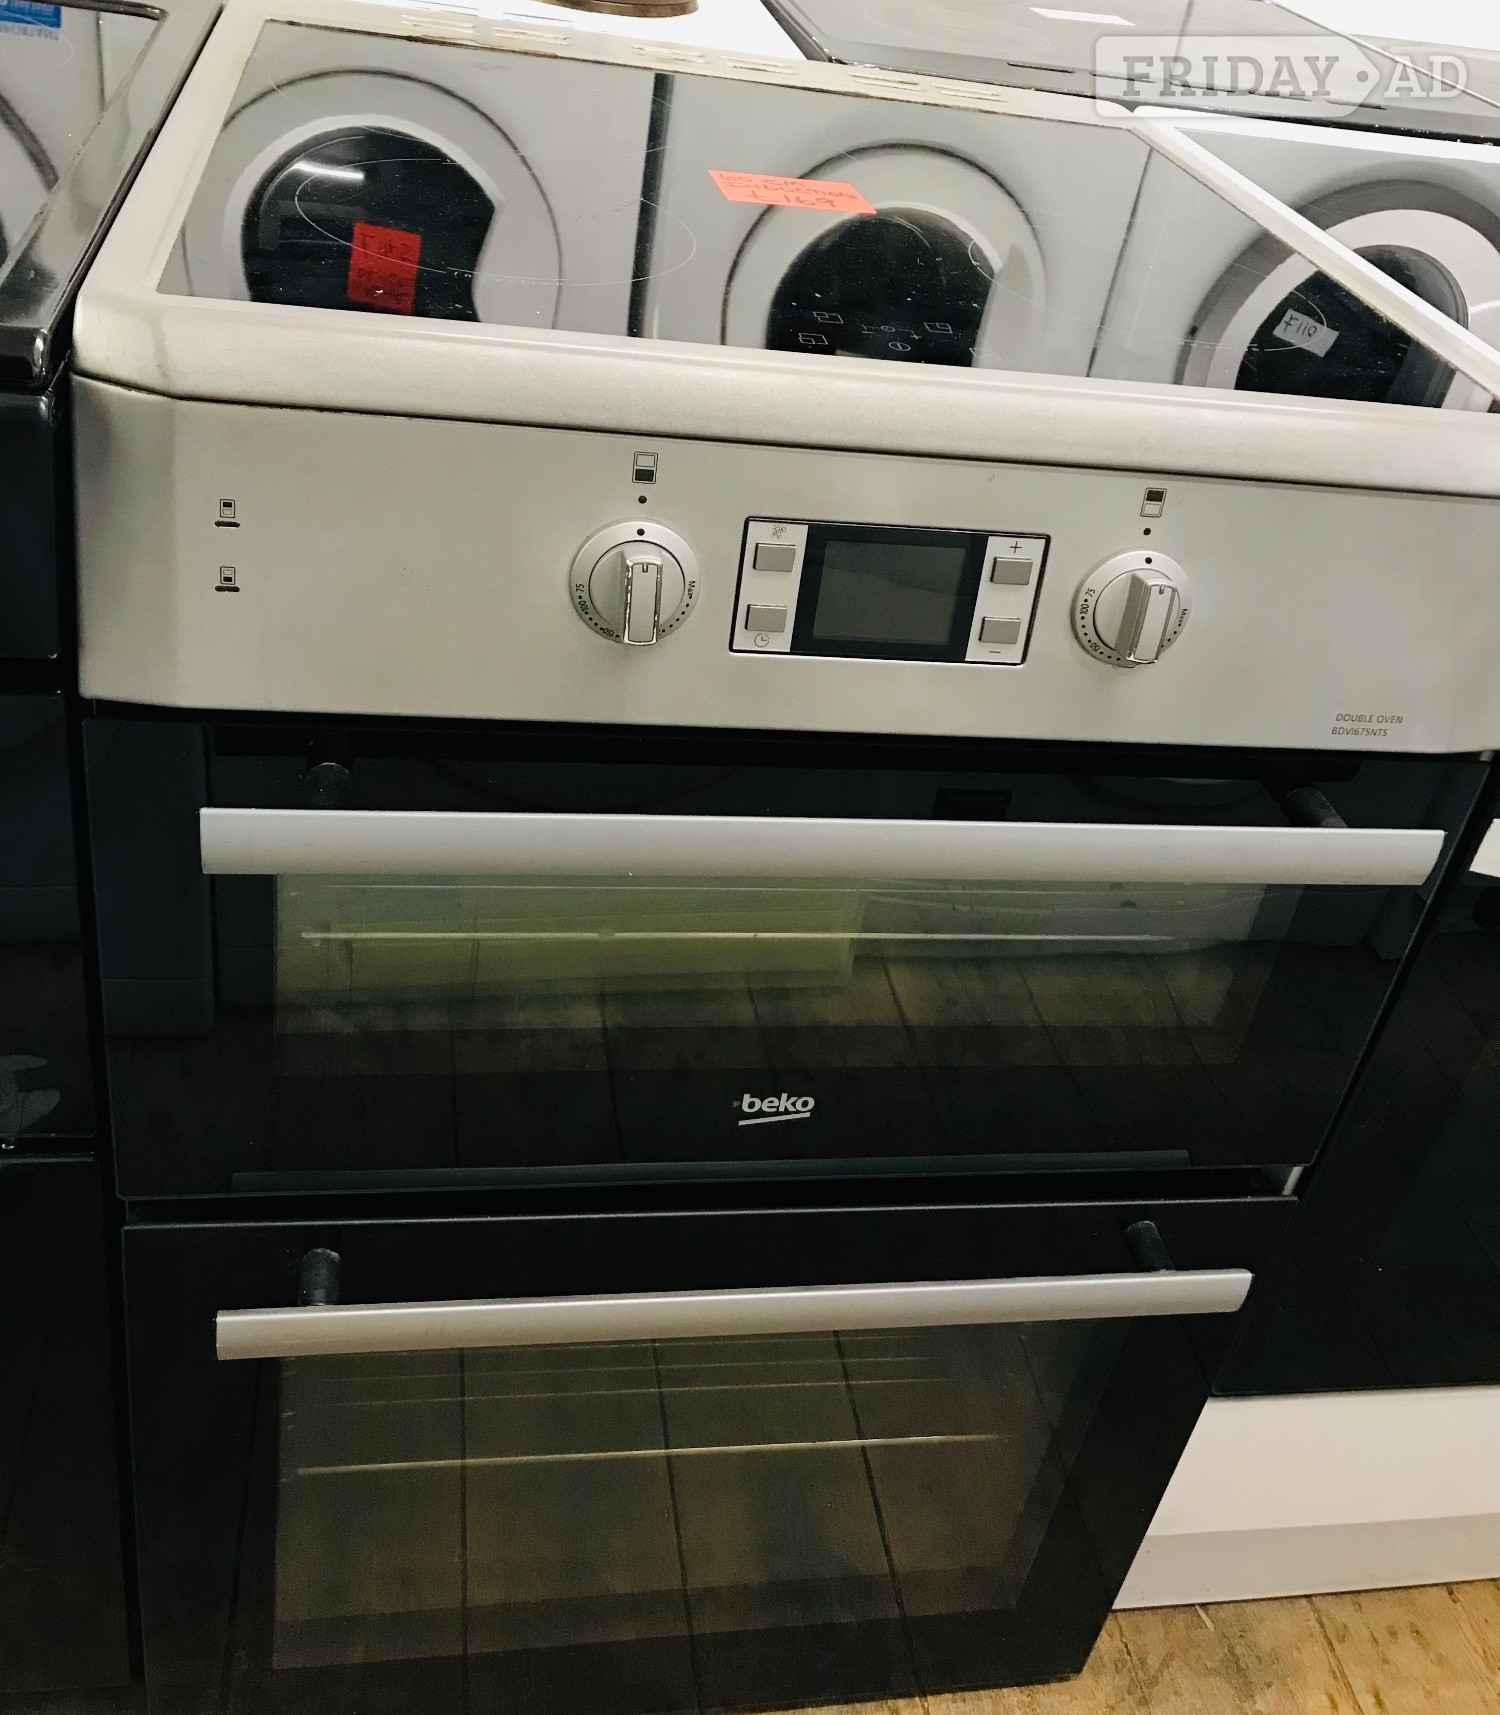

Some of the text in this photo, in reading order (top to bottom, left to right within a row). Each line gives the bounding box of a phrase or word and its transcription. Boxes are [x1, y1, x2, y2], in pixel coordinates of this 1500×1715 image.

[745, 190, 837, 208] £169
[575, 583, 585, 593] 75
[1085, 587, 1096, 598] 75
[1079, 603, 1090, 615] 100
[1335, 713, 1404, 724] DOUBLE OVEN
[741, 1092, 815, 1114] beko
